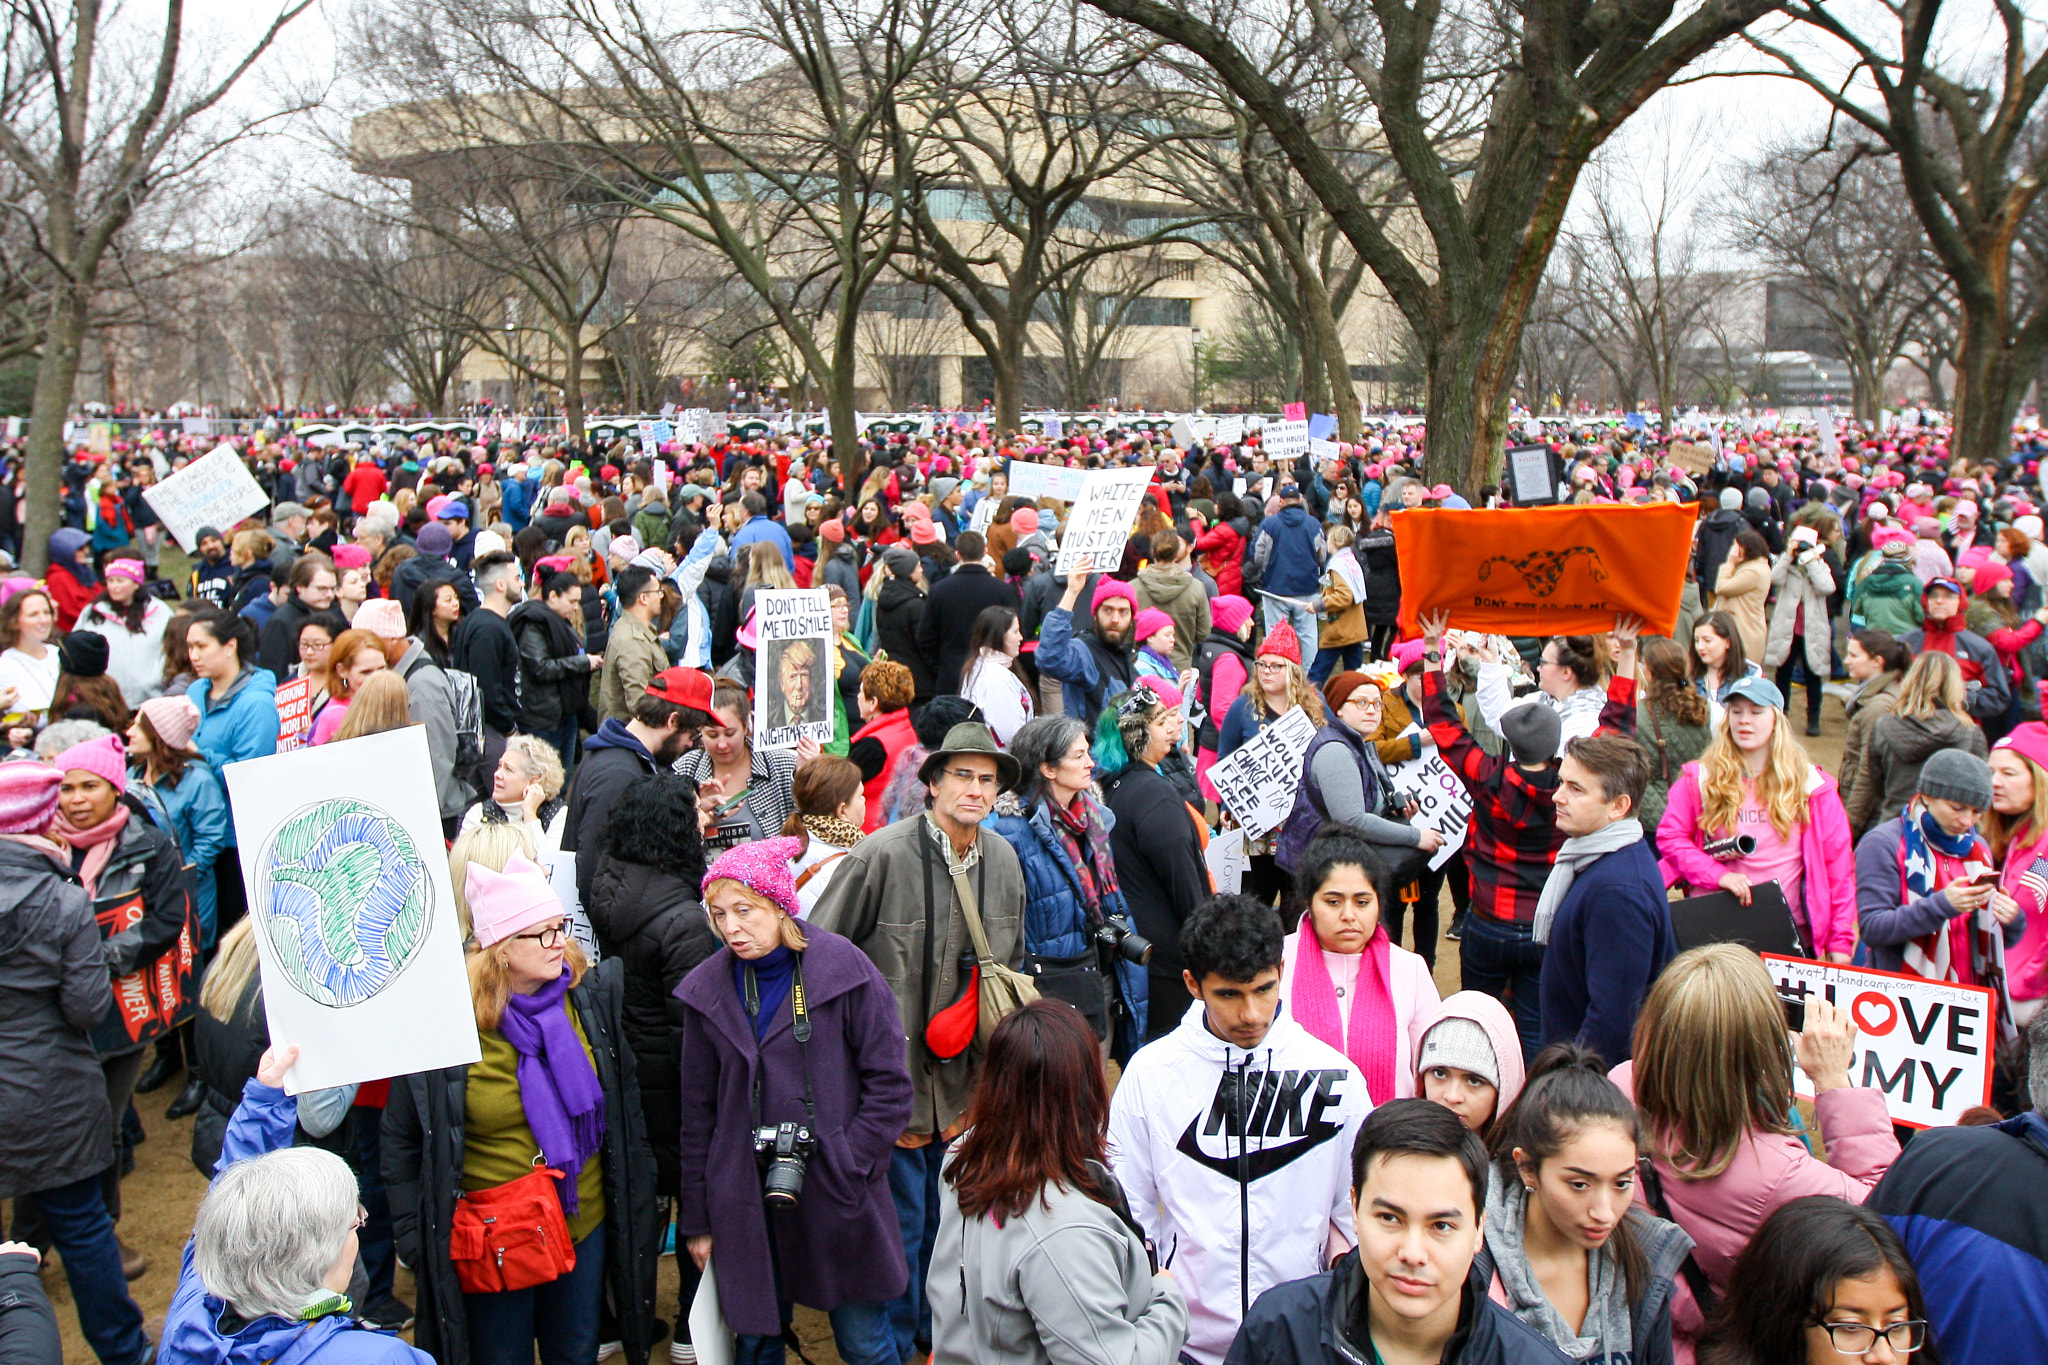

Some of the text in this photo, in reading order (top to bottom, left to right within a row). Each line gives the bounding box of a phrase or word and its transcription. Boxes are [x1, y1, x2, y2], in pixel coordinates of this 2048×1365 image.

[1283, 446, 1307, 455] SENATE
[1286, 435, 1306, 443] HOUSE
[151, 486, 174, 503] THE
[177, 463, 209, 487] POWER
[1013, 464, 1050, 479] PLANET
[1020, 480, 1048, 493] FIRST
[160, 494, 185, 513] THE
[185, 470, 220, 498] PEOPLE
[177, 479, 236, 518] STRONGER
[1090, 483, 1144, 502] WHITE
[175, 481, 257, 536] THAN THE PEOPLE
[1086, 507, 1127, 527] MEN
[1066, 530, 1127, 549] MUST DO
[799, 597, 826, 613] TELL
[762, 615, 830, 639] ME TO SMILE
[277, 698, 308, 720] OMEN OF
[759, 721, 831, 748] NIGHTMARE MAN
[1278, 710, 1313, 749] HOW
[1266, 728, 1298, 779] WOUL
[1233, 748, 1290, 819] CHARGE FOR
[1417, 756, 1447, 786] ME
[1222, 764, 1261, 811] FREE
[1430, 791, 1474, 846] MILE
[1738, 809, 1767, 823] NICE
[719, 827, 750, 837] PUSSY
[180, 927, 192, 966] DIES
[119, 971, 149, 1022] OWER
[159, 963, 176, 1011] MINDS
[795, 985, 805, 1015] Nikon
[1203, 1069, 1348, 1137] NIKE
